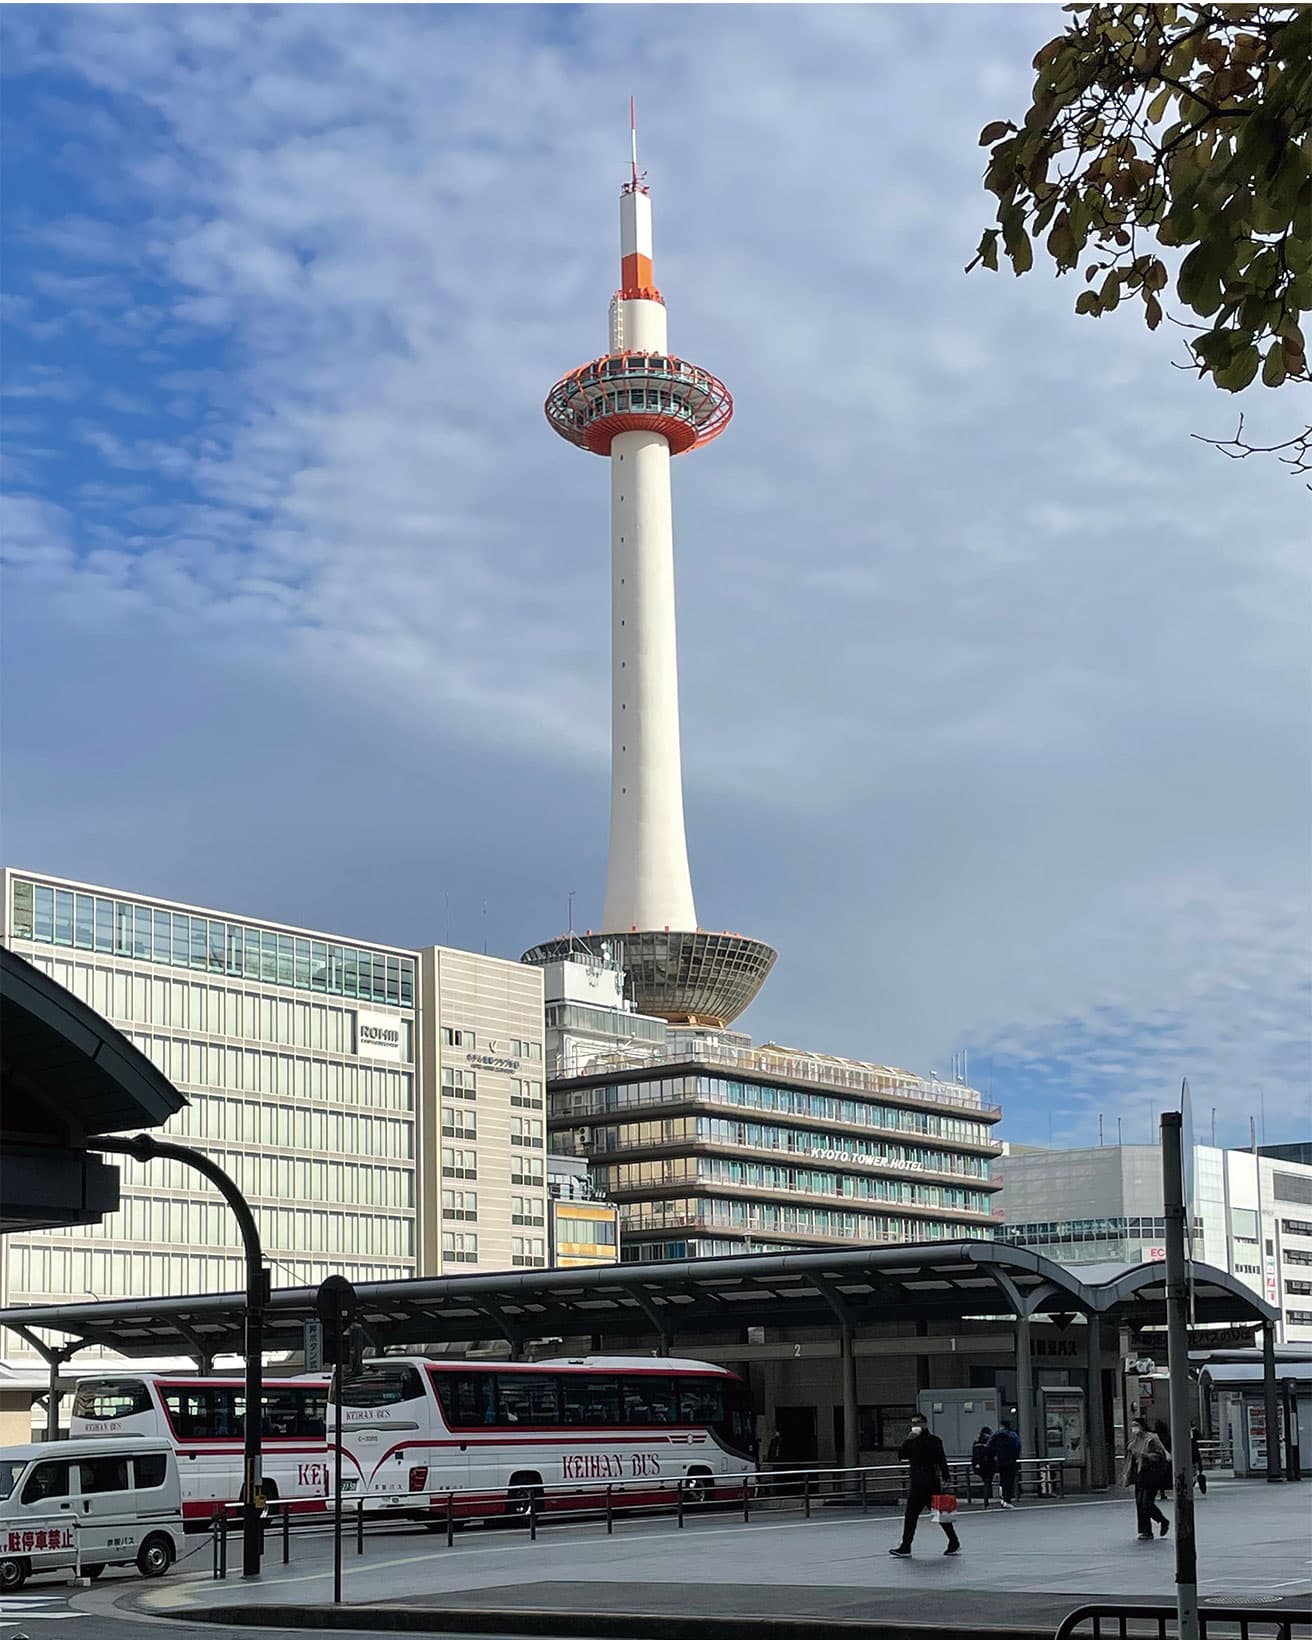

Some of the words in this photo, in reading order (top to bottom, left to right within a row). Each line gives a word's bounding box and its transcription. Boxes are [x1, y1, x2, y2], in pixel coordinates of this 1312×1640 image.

[360, 1025, 399, 1042] ROHM
[811, 1148, 849, 1162] KYOTO
[852, 1153, 888, 1167] TOWER
[890, 1159, 925, 1172] HOTEL
[794, 1344, 801, 1357] 2
[950, 1338, 956, 1352] 1
[562, 1454, 623, 1479] KEIHAN
[631, 1452, 660, 1476] BUS
